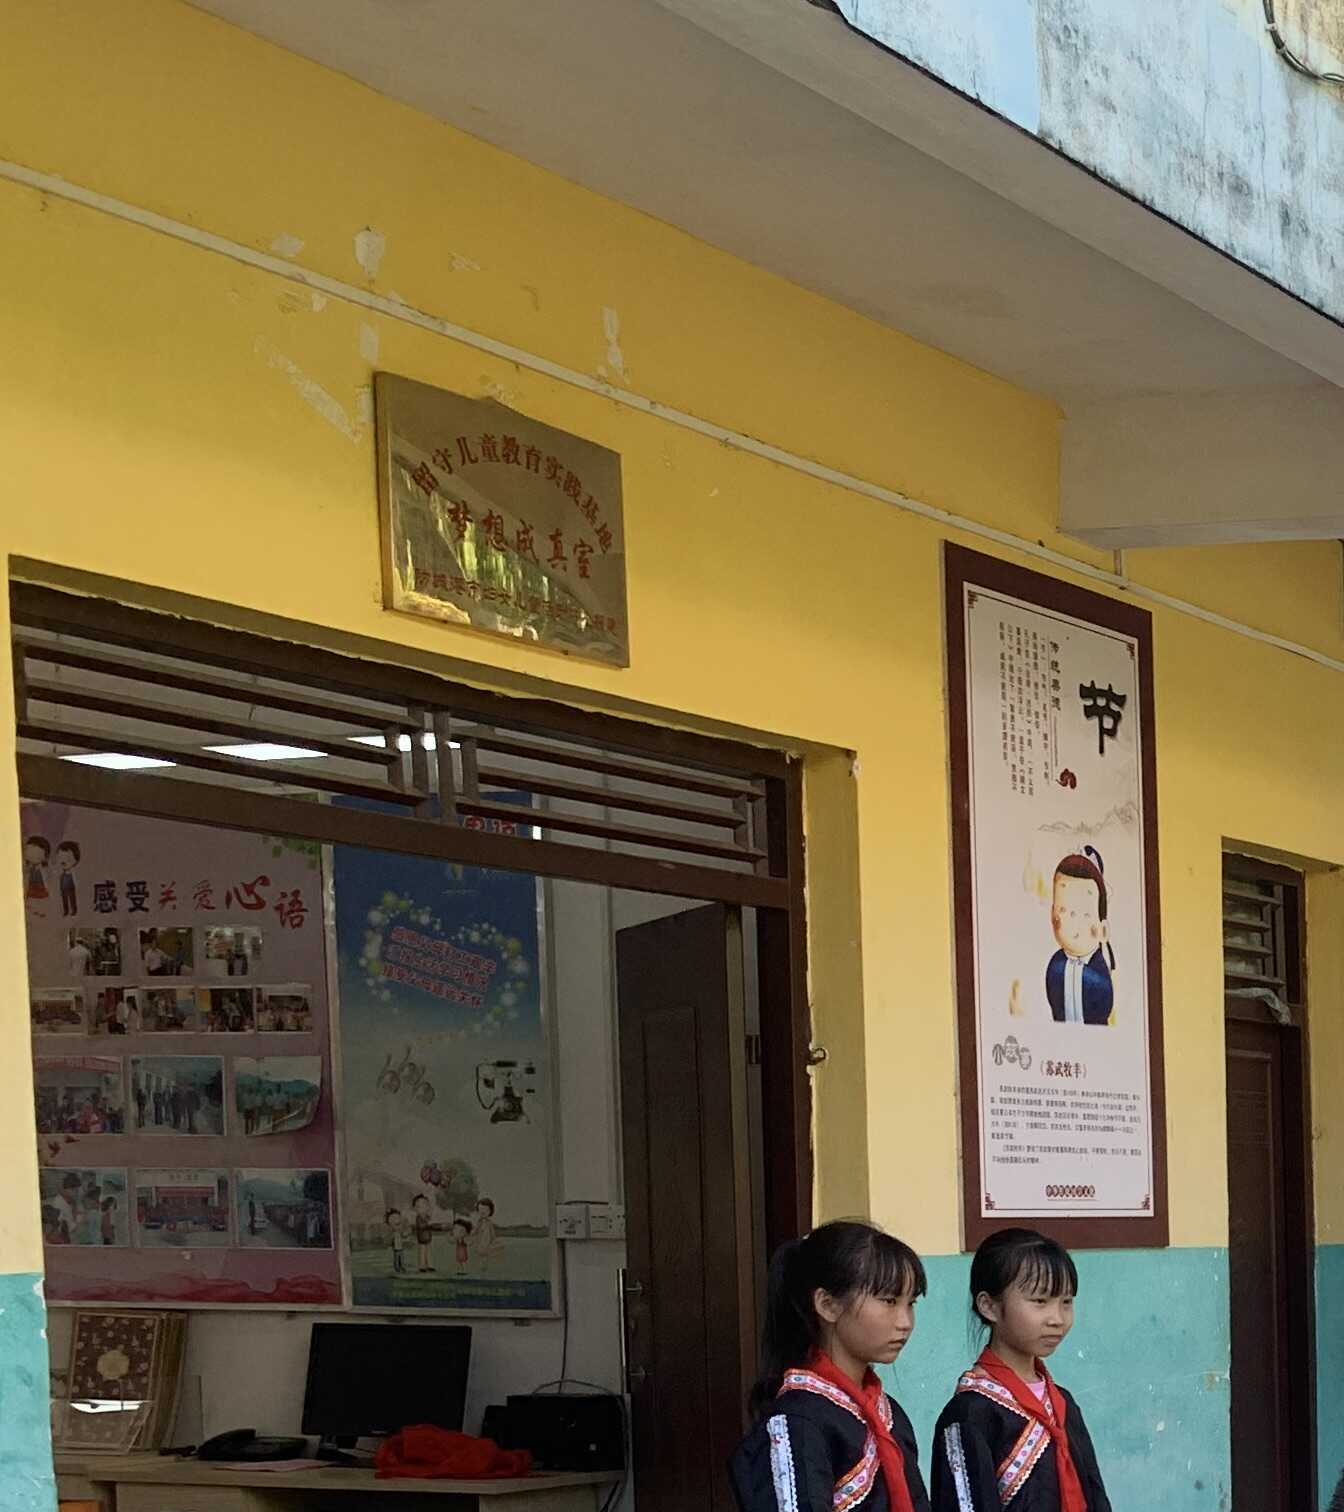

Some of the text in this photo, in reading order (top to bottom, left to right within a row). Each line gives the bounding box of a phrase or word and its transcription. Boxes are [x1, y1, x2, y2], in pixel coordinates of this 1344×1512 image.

[411, 432, 614, 555] 留守儿童教育实践基地
[446, 499, 595, 580] 梦想成真室
[1078, 679, 1128, 758] 节
[93, 875, 309, 929] 感受关爱心语
